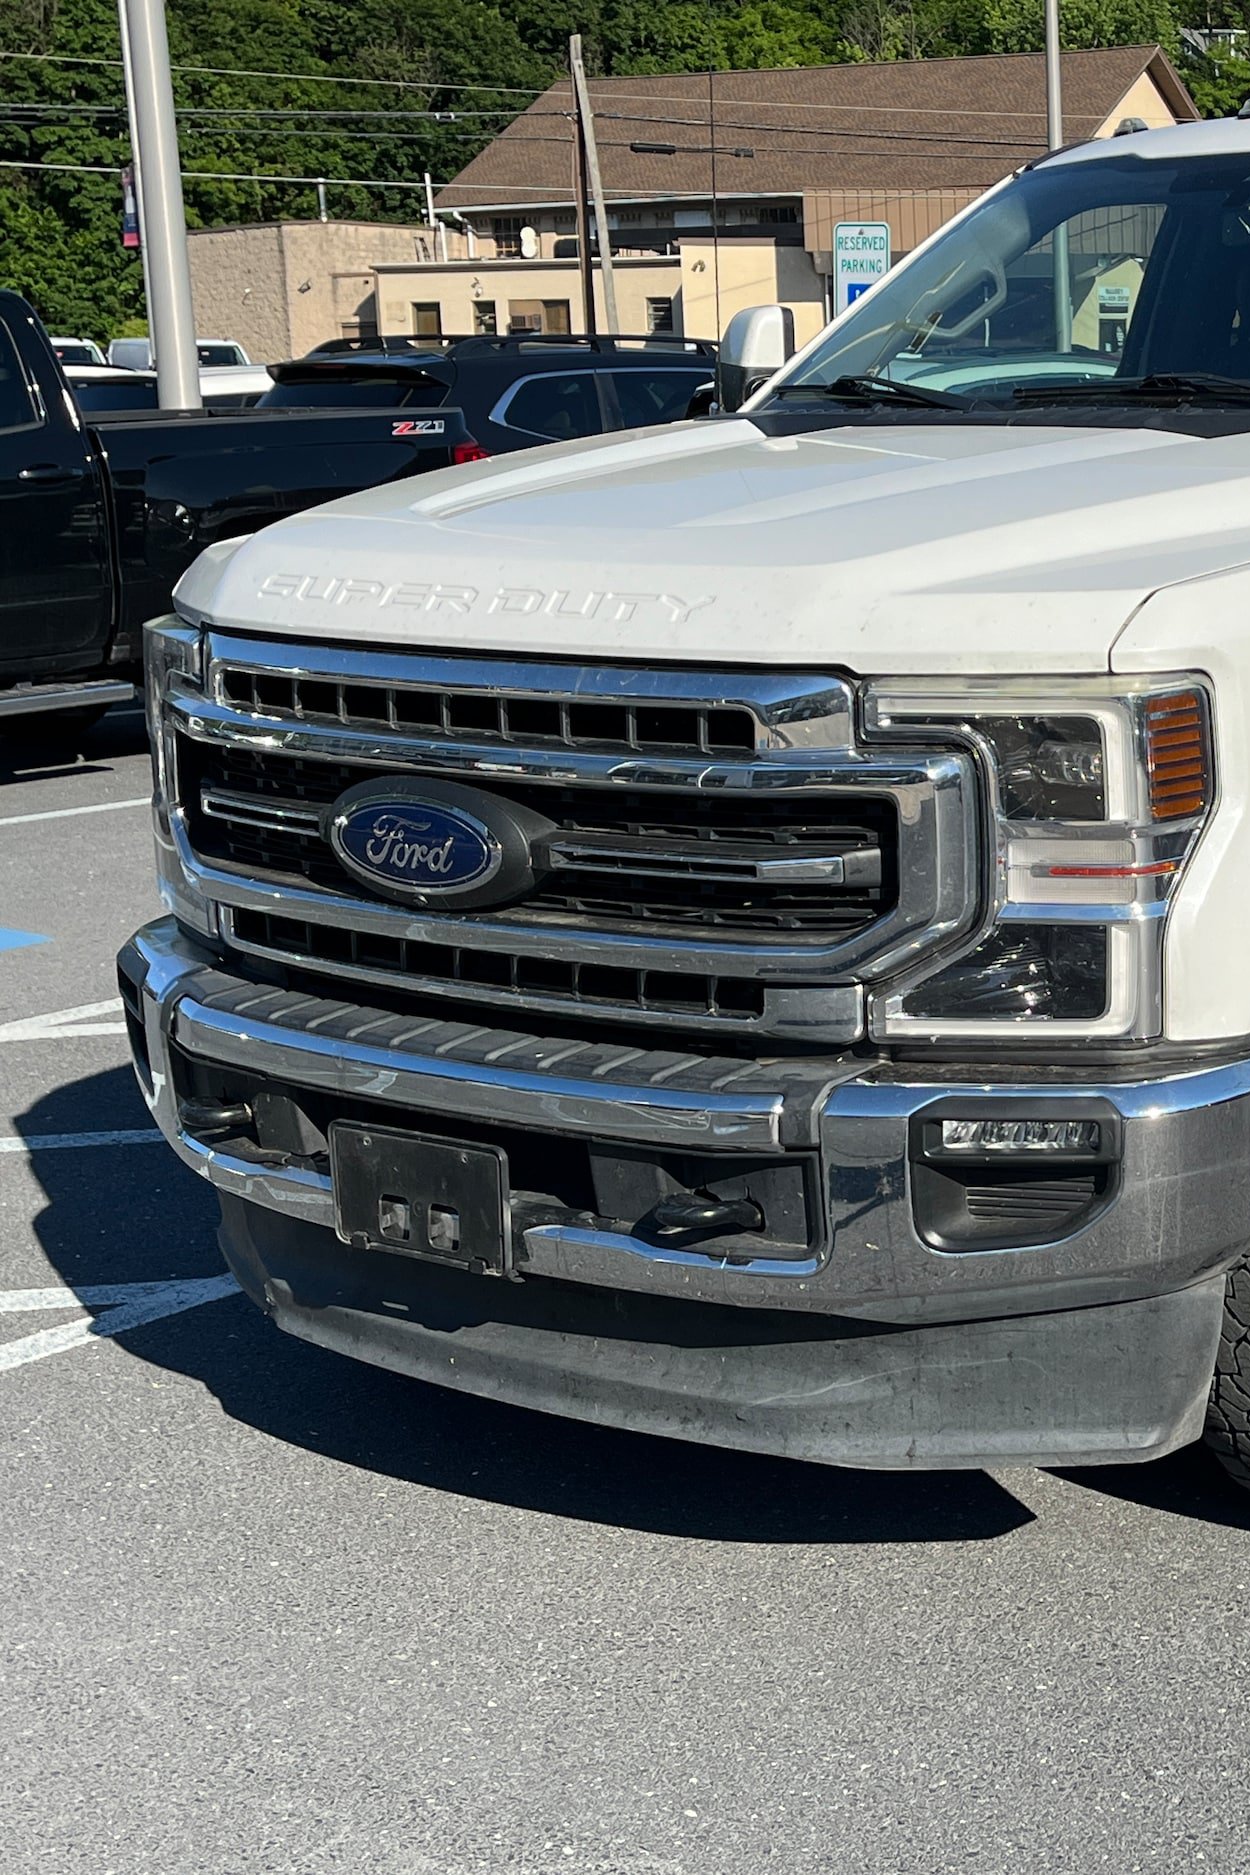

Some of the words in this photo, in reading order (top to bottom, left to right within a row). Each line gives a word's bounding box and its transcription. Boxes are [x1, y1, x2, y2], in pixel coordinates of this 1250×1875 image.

[837, 237, 885, 250] RESERVED
[841, 259, 882, 273] PARKING
[392, 420, 445, 436] Z71
[257, 573, 480, 614] SUPER
[487, 587, 718, 624] DUTY
[366, 814, 455, 873] Ford
